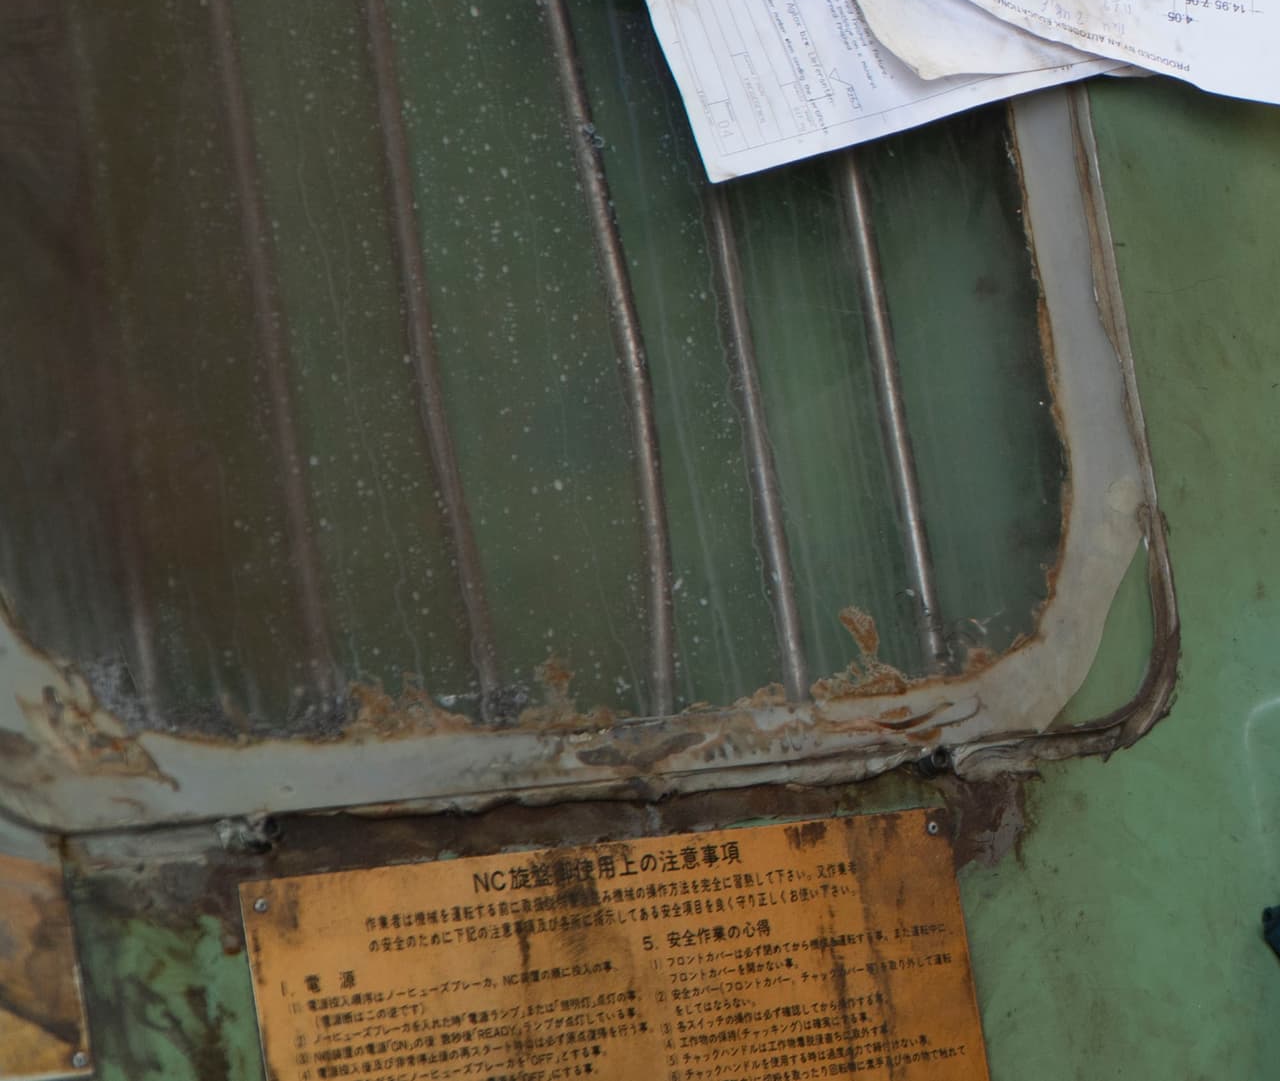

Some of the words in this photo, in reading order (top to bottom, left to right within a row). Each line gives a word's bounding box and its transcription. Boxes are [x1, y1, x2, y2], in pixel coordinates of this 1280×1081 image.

[1215, 0, 1246, 13] 14.95
[666, 918, 771, 948] 安全作業の心得
